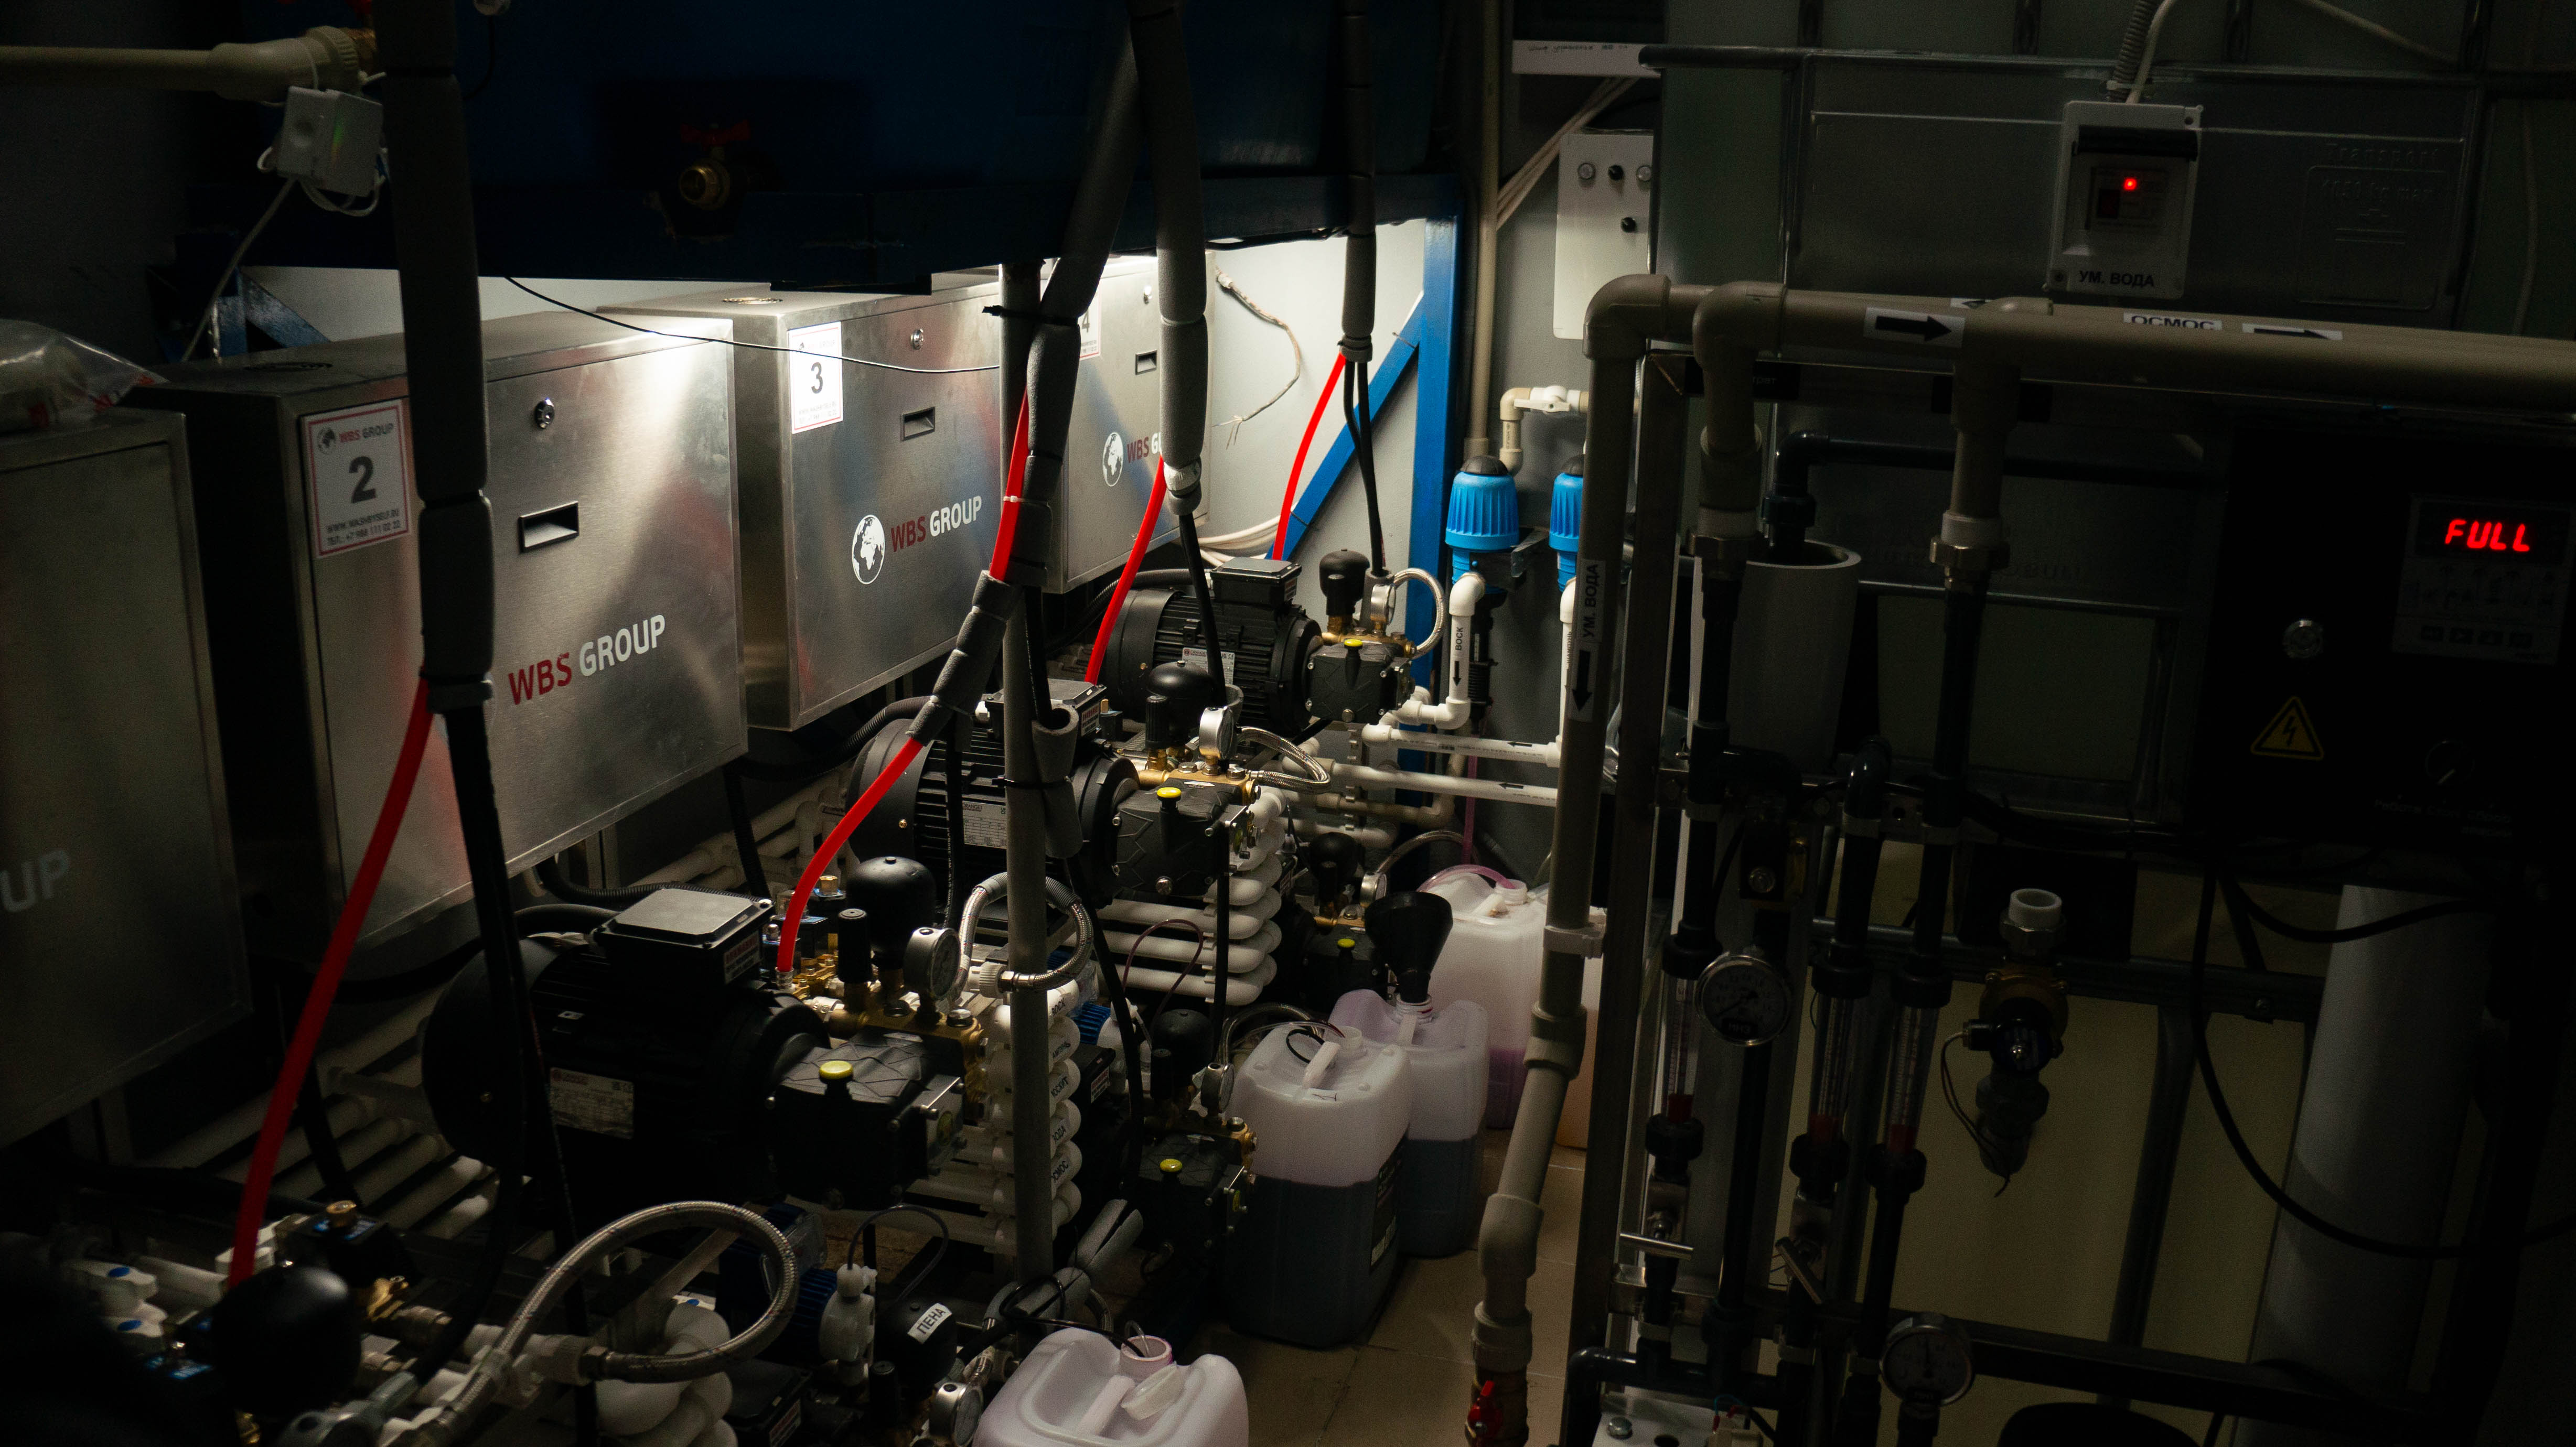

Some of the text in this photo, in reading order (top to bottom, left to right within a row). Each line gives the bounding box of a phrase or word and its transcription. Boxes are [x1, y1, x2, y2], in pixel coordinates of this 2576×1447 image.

[2079, 271, 2155, 287] УМ. ВОДА
[2131, 316, 2214, 330] ОСМОС
[811, 362, 823, 394] 3
[339, 423, 393, 443] WBS GROUP
[1126, 436, 1150, 463] WBS
[349, 456, 377, 504] 2
[890, 495, 982, 552] WBS GROUP
[2444, 518, 2531, 553] FULL
[1582, 564, 1600, 638] УМ. ВОДА
[1455, 627, 1464, 651] ВОСК
[508, 614, 666, 705] WBS GROUP
[917, 1308, 946, 1335] ПЕНА
